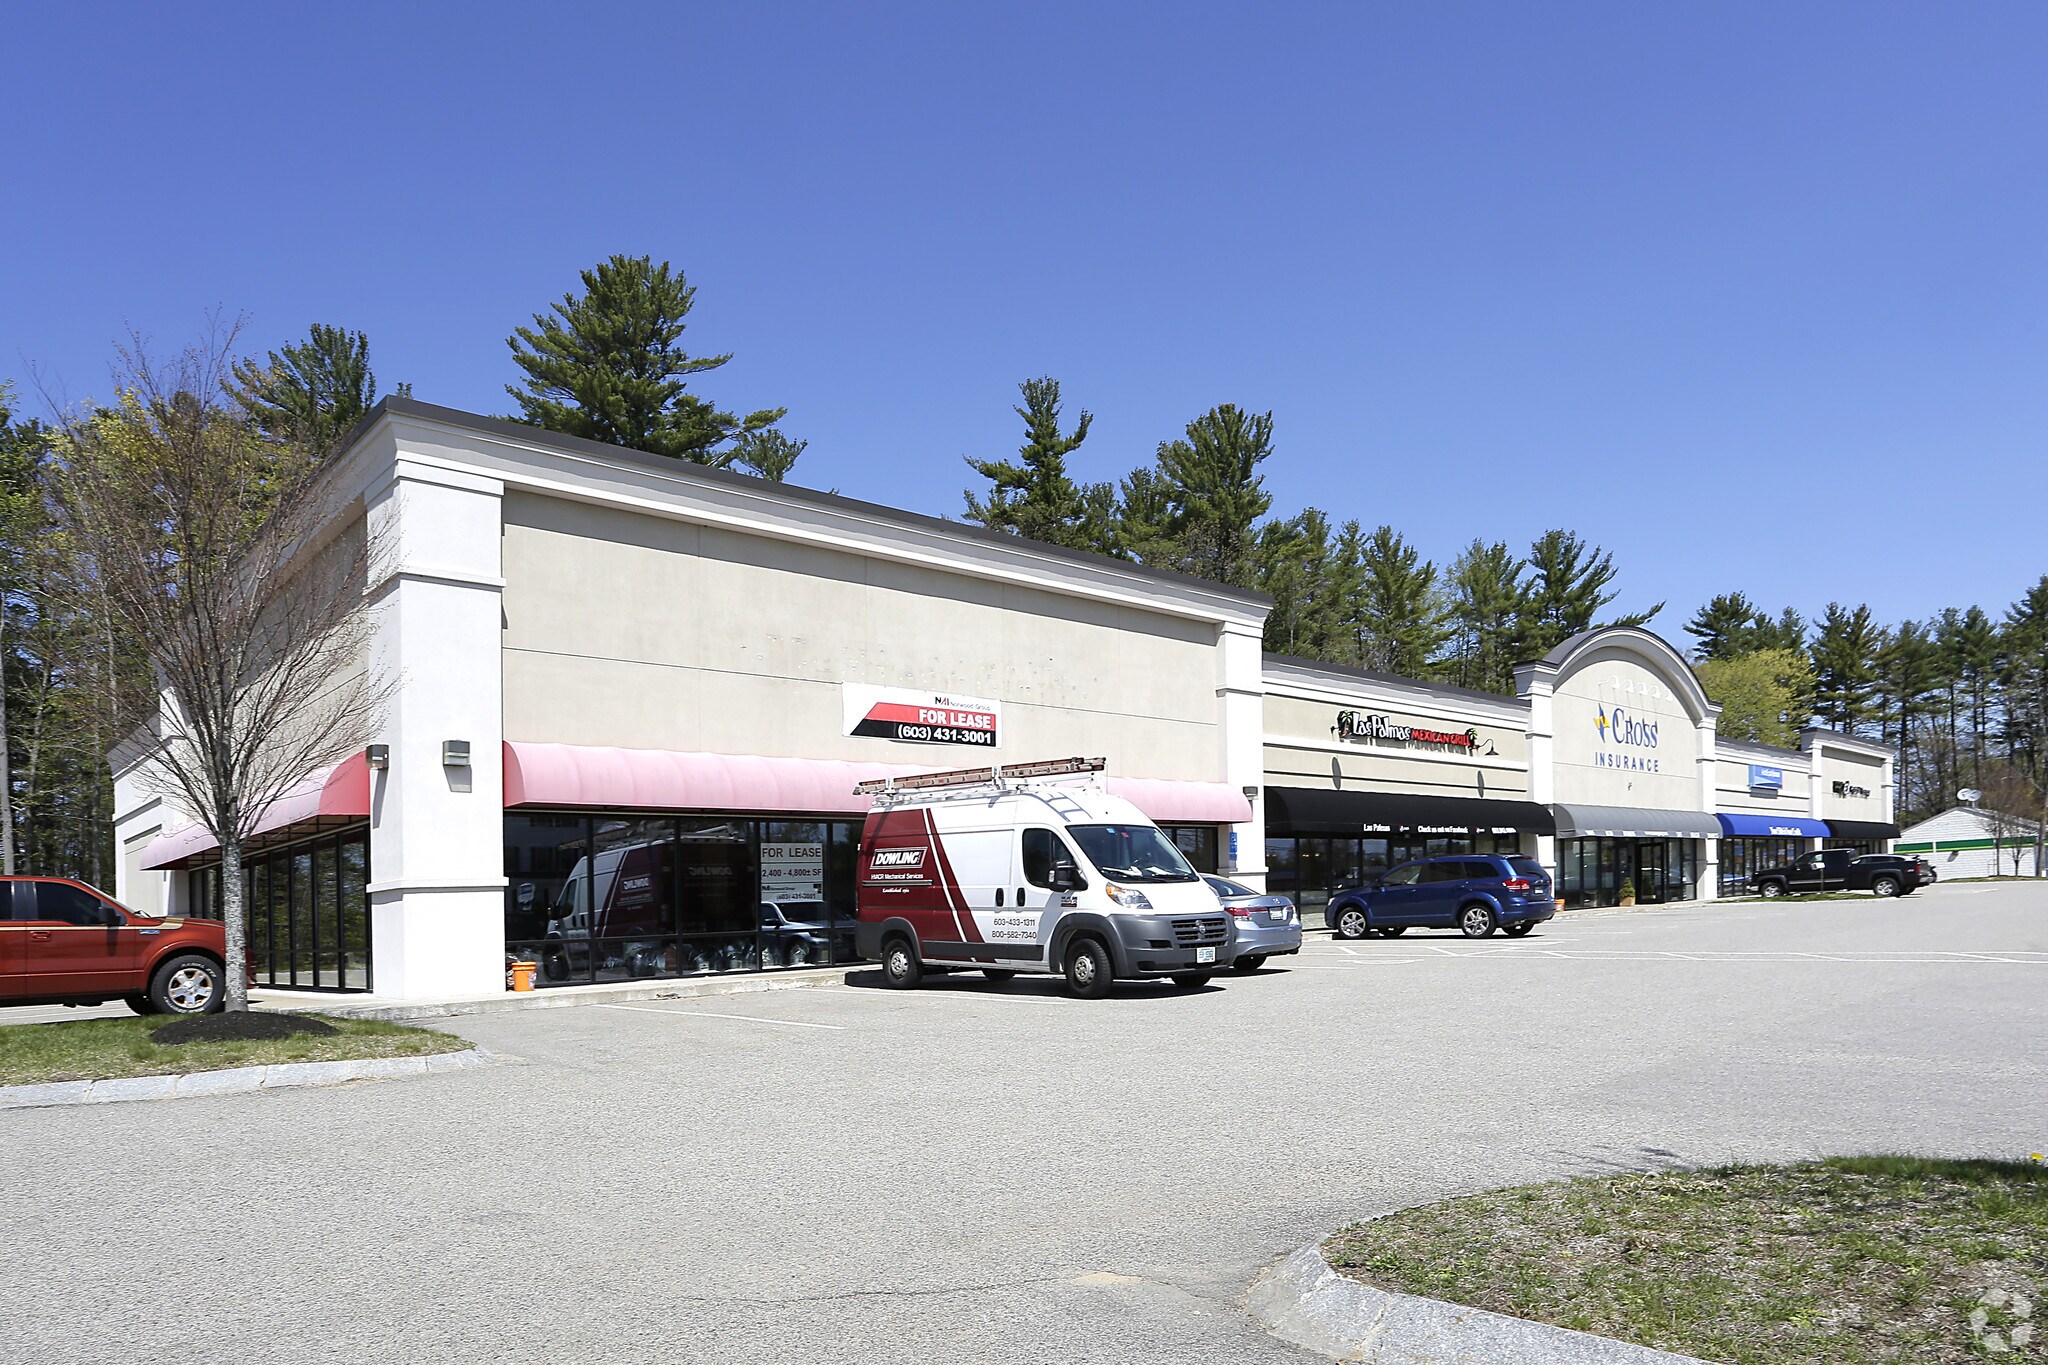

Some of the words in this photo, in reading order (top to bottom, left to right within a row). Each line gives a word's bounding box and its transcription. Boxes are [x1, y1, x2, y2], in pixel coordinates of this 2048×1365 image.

[919, 709, 947, 725] FOR
[950, 711, 992, 729] LEASE
[898, 724, 931, 741] (603)
[934, 726, 992, 744] 431-3001
[1352, 712, 1372, 736] Las
[1372, 715, 1411, 741] Palmas
[1411, 728, 1450, 744] MEXICAN
[1450, 734, 1470, 747] GRILL
[1595, 751, 1659, 773] INSURANCE
[762, 847, 784, 858] FOR
[789, 847, 822, 858] LEASE
[875, 851, 920, 865] DOWLING
[762, 869, 782, 878] 2,400
[812, 868, 822, 877] SF
[993, 918, 1036, 927] 603-433-1311
[991, 930, 1038, 939] 800-582-7340
